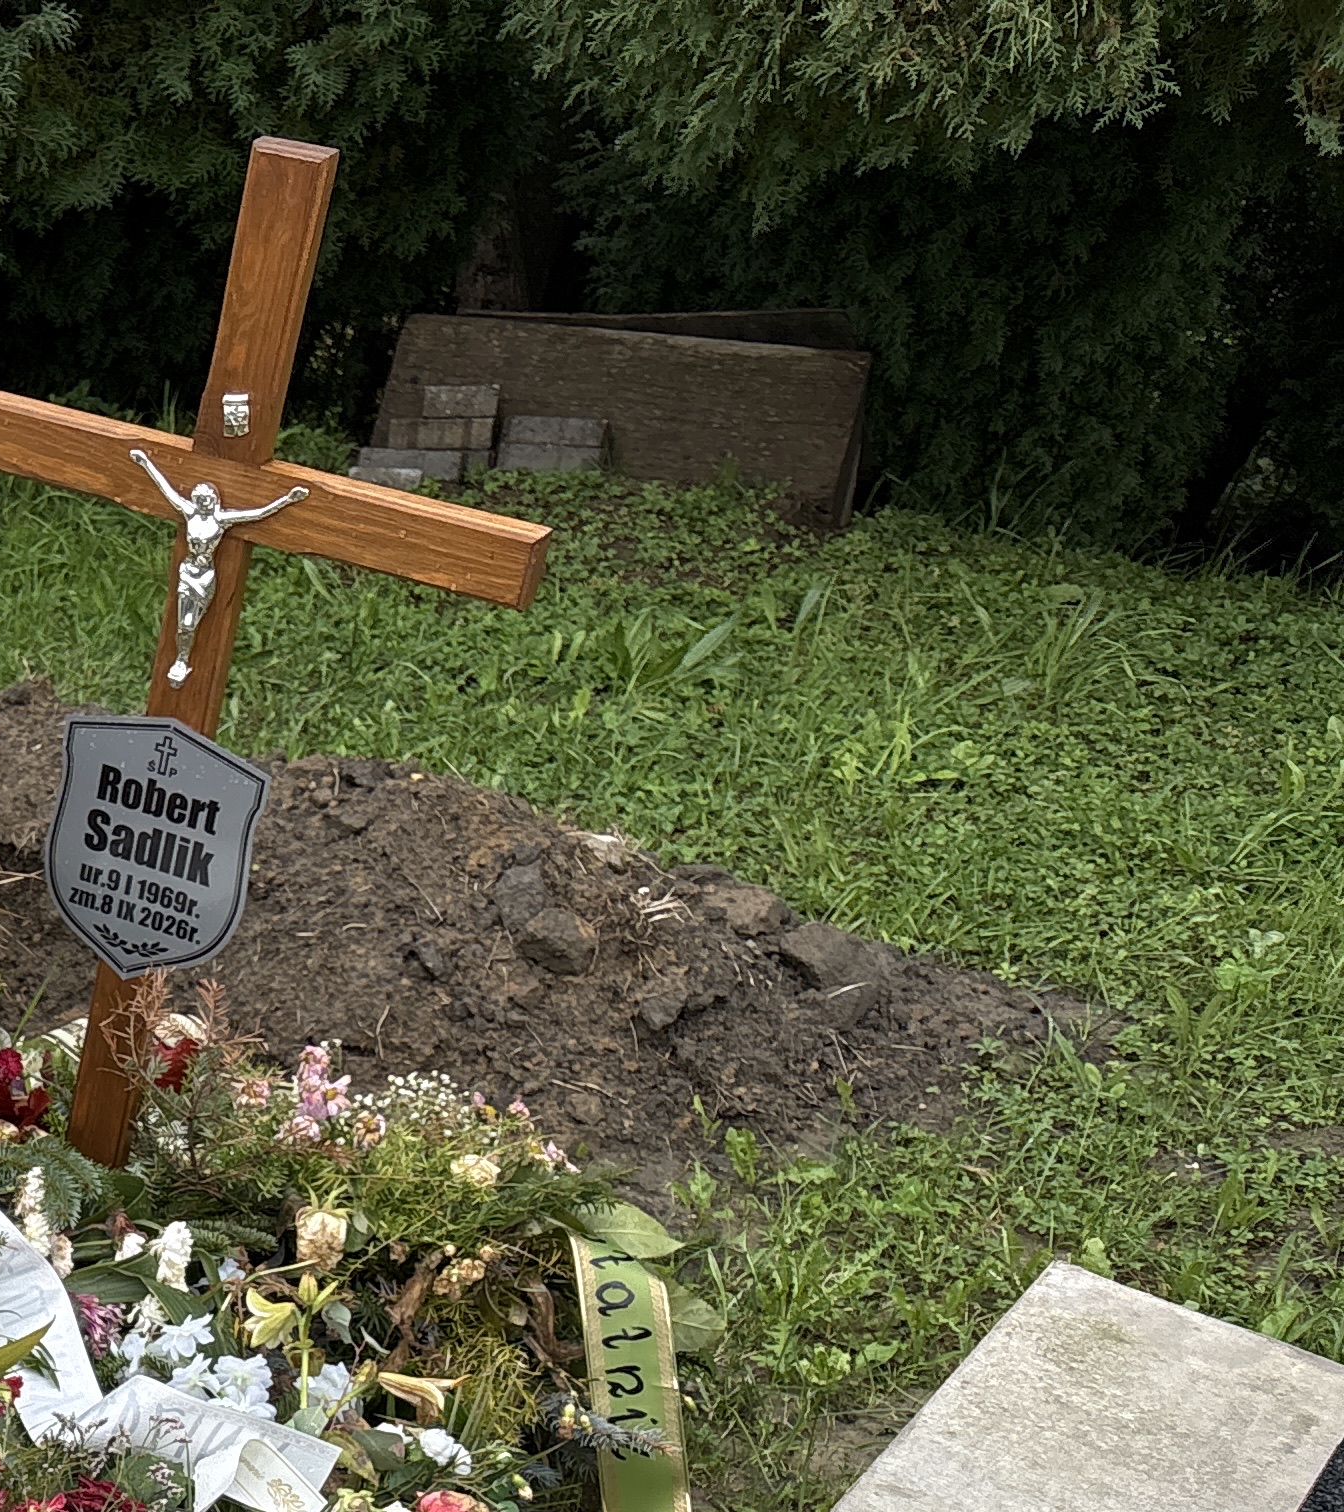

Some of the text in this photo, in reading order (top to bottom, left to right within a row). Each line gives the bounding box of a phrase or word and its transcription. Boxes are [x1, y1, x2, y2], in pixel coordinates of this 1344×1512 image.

[96, 763, 221, 836] Robert
[84, 808, 214, 888] Sadlik
[116, 900, 137, 924] IX
[138, 907, 201, 945] 2026r.
[137, 878, 201, 919] 1969r.
